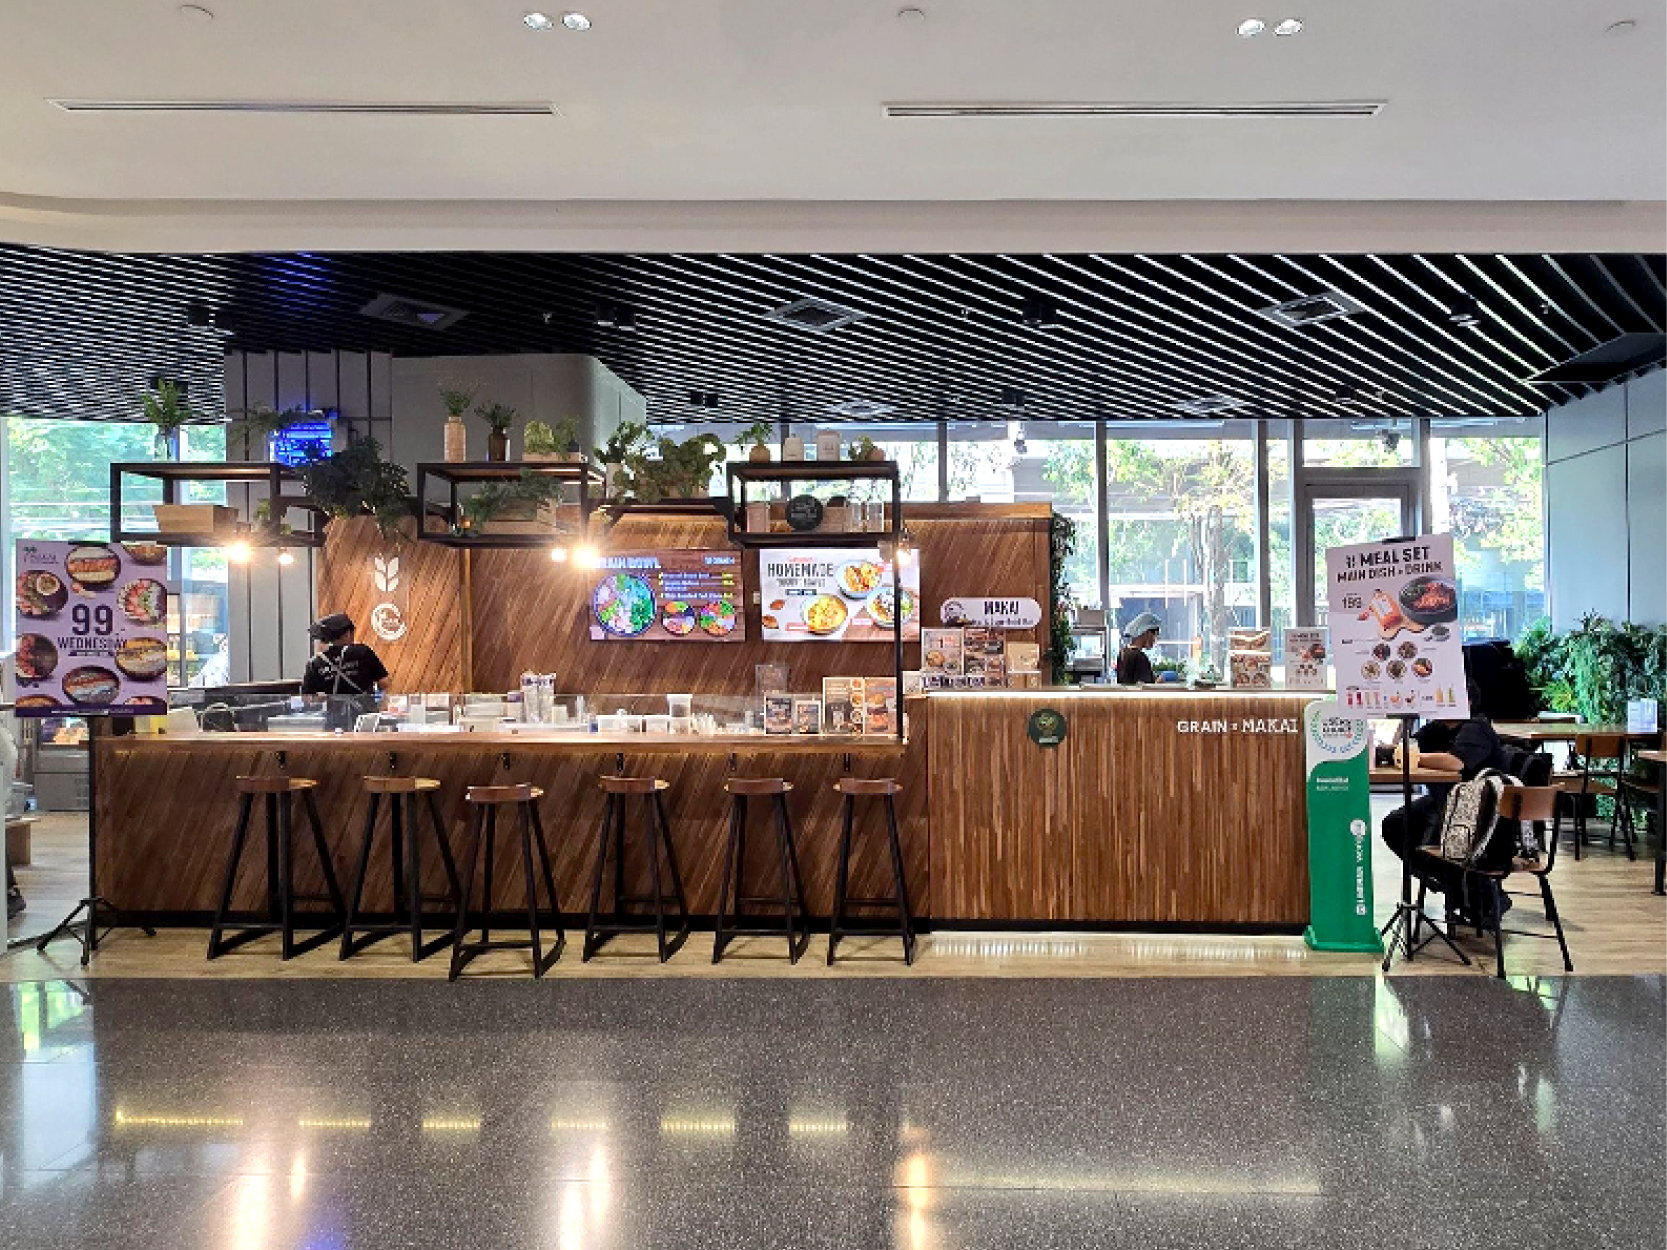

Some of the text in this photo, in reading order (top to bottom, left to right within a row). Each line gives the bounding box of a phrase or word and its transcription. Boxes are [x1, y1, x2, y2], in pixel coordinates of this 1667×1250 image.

[1360, 549, 1399, 567] MEAL
[1403, 546, 1430, 563] SET
[768, 563, 834, 577] HOMEMADE
[1337, 569, 1366, 583] MAIN
[1368, 566, 1395, 579] DISH
[1405, 561, 1443, 575] DRINK
[58, 637, 127, 649] WEDNESDAY
[1176, 720, 1228, 733] GRAIN
[1240, 718, 1299, 733] MAKAI
